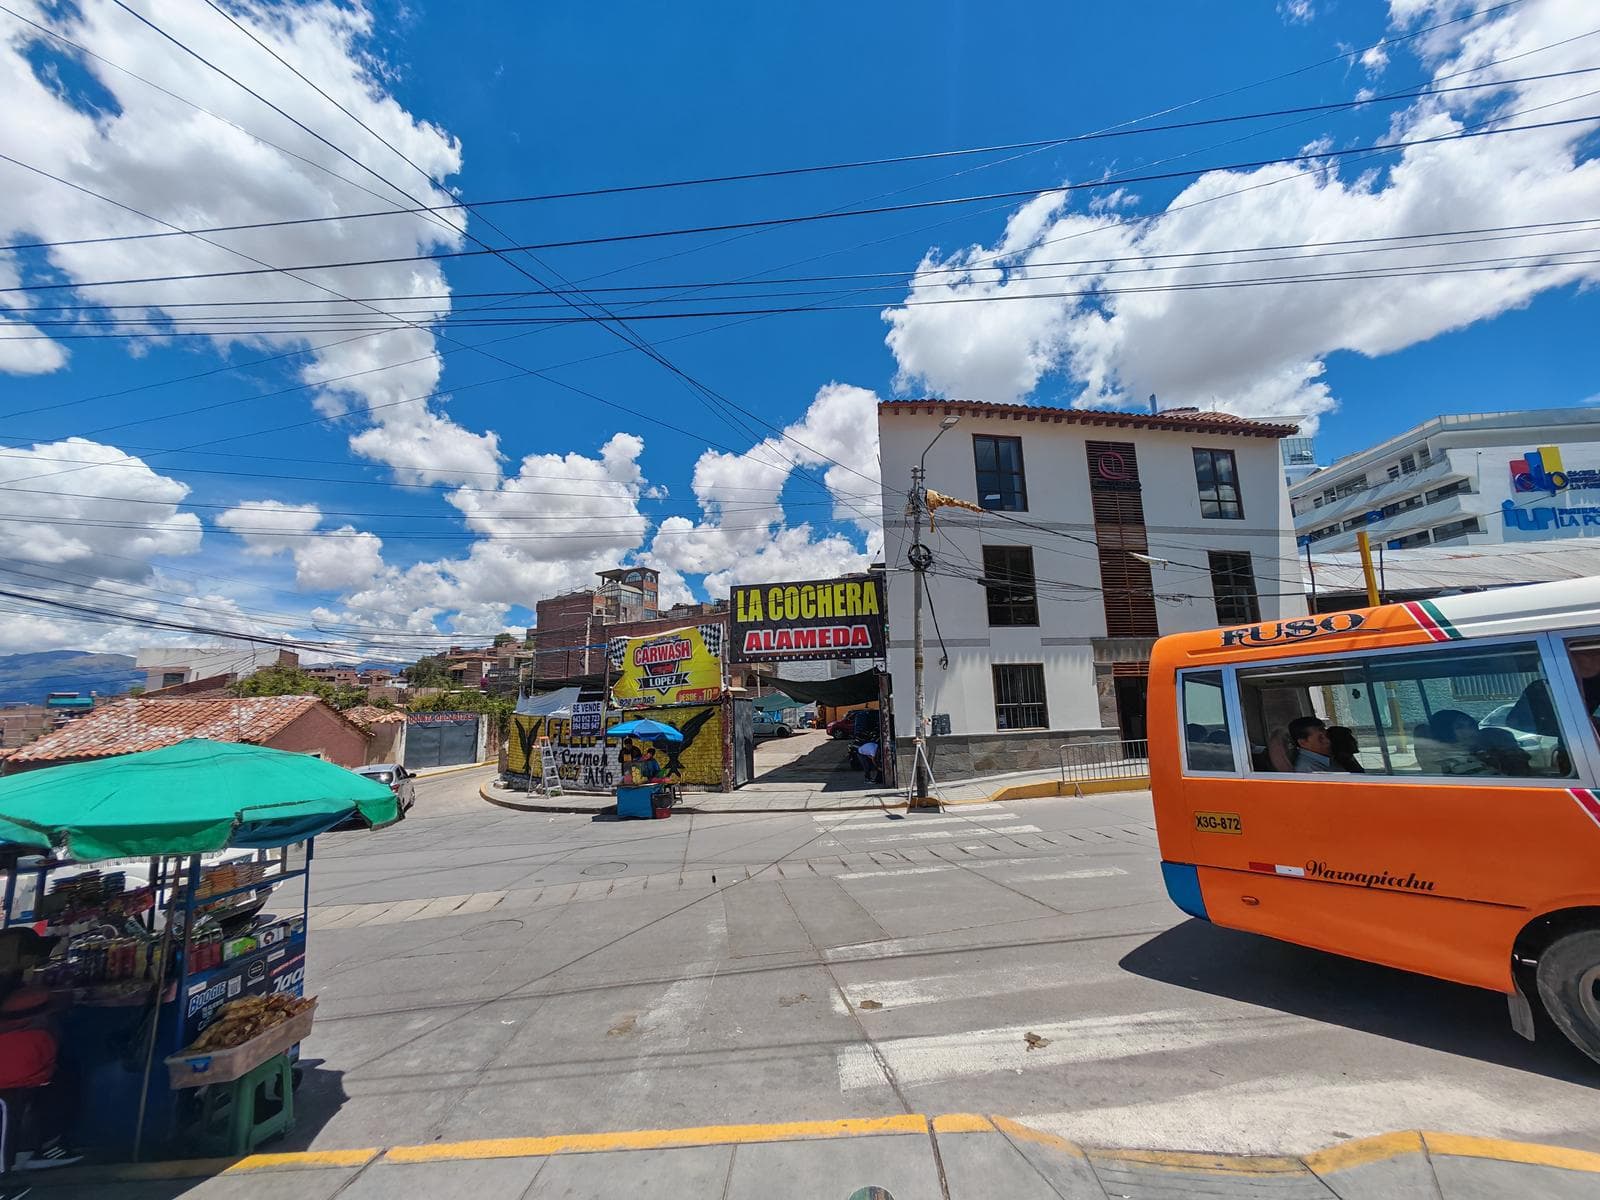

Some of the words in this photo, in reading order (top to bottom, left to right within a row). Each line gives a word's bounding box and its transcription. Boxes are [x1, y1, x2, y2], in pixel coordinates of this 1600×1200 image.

[1560, 515, 1580, 527] LA
[737, 589, 764, 622] LA
[768, 581, 879, 621] COCHERA
[744, 626, 871, 653] ALAMEDA
[1221, 613, 1366, 648] FUSO
[634, 640, 691, 666] CARWASH
[649, 676, 677, 687] LOPEZ
[572, 703, 580, 713] SE
[581, 703, 601, 712] VENDE
[560, 749, 608, 767] Carmen
[583, 766, 613, 787] Alto
[1195, 815, 1242, 831] X3G-872
